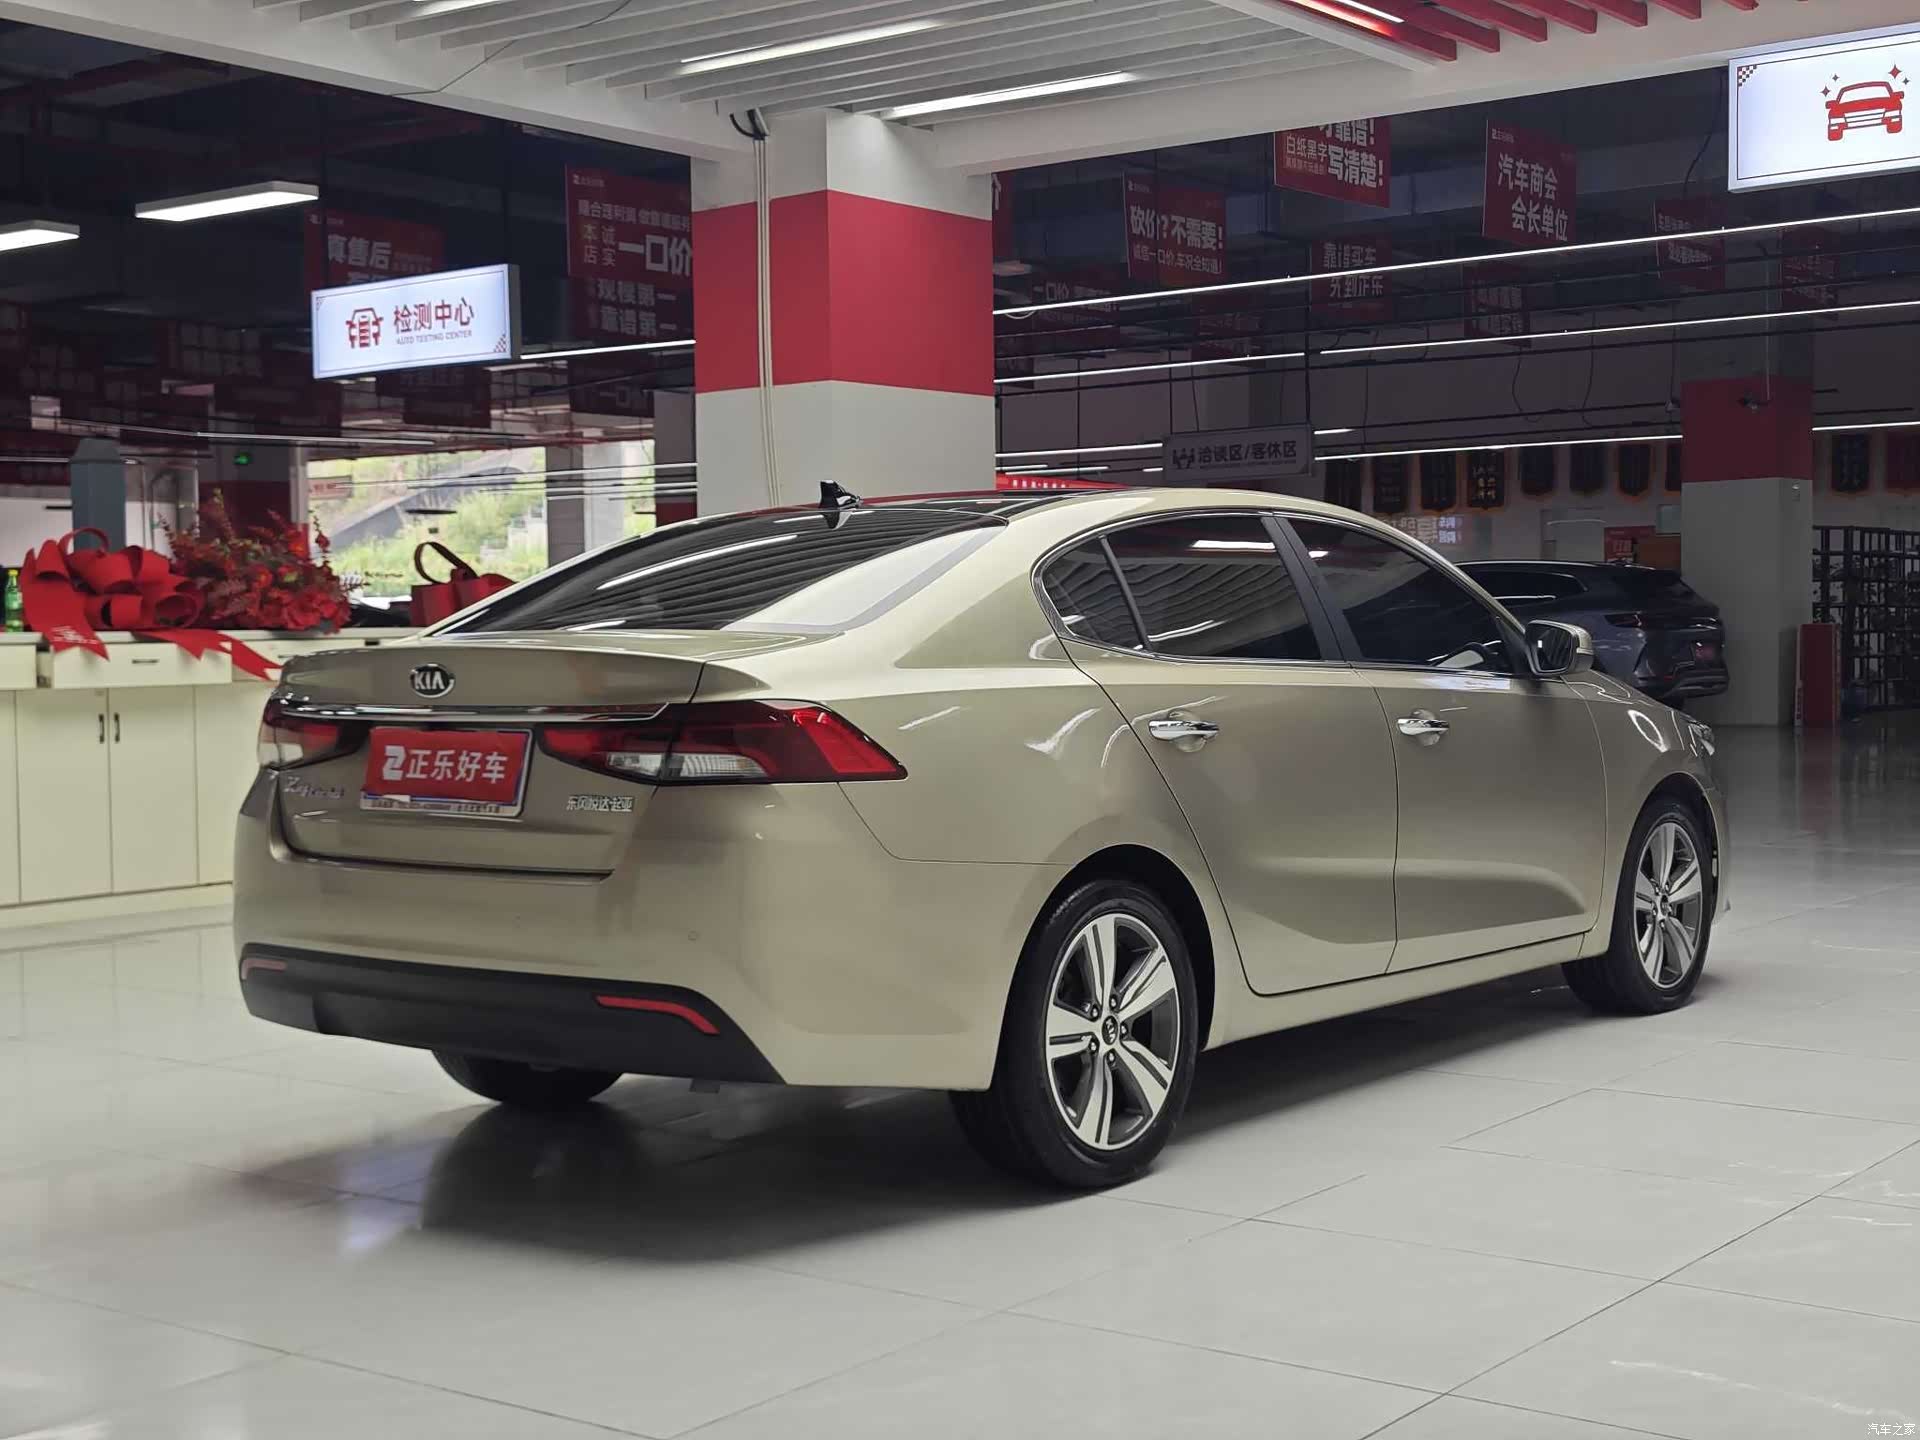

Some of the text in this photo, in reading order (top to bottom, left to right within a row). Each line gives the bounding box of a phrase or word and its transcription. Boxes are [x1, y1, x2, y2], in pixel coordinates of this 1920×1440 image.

[1328, 144, 1384, 189] 写清楚!
[1498, 152, 1558, 201] 汽车商会
[1129, 204, 1224, 251] 砍价?不需要!
[1511, 194, 1568, 241] 会长单位
[618, 233, 691, 278] 一口价
[394, 297, 475, 334] 检测中心
[1198, 440, 1297, 463] 洽谈区/客休区
[414, 670, 446, 691] KIA
[405, 748, 508, 784] 正乐好车
[566, 795, 633, 812] 东风悦达起亚
